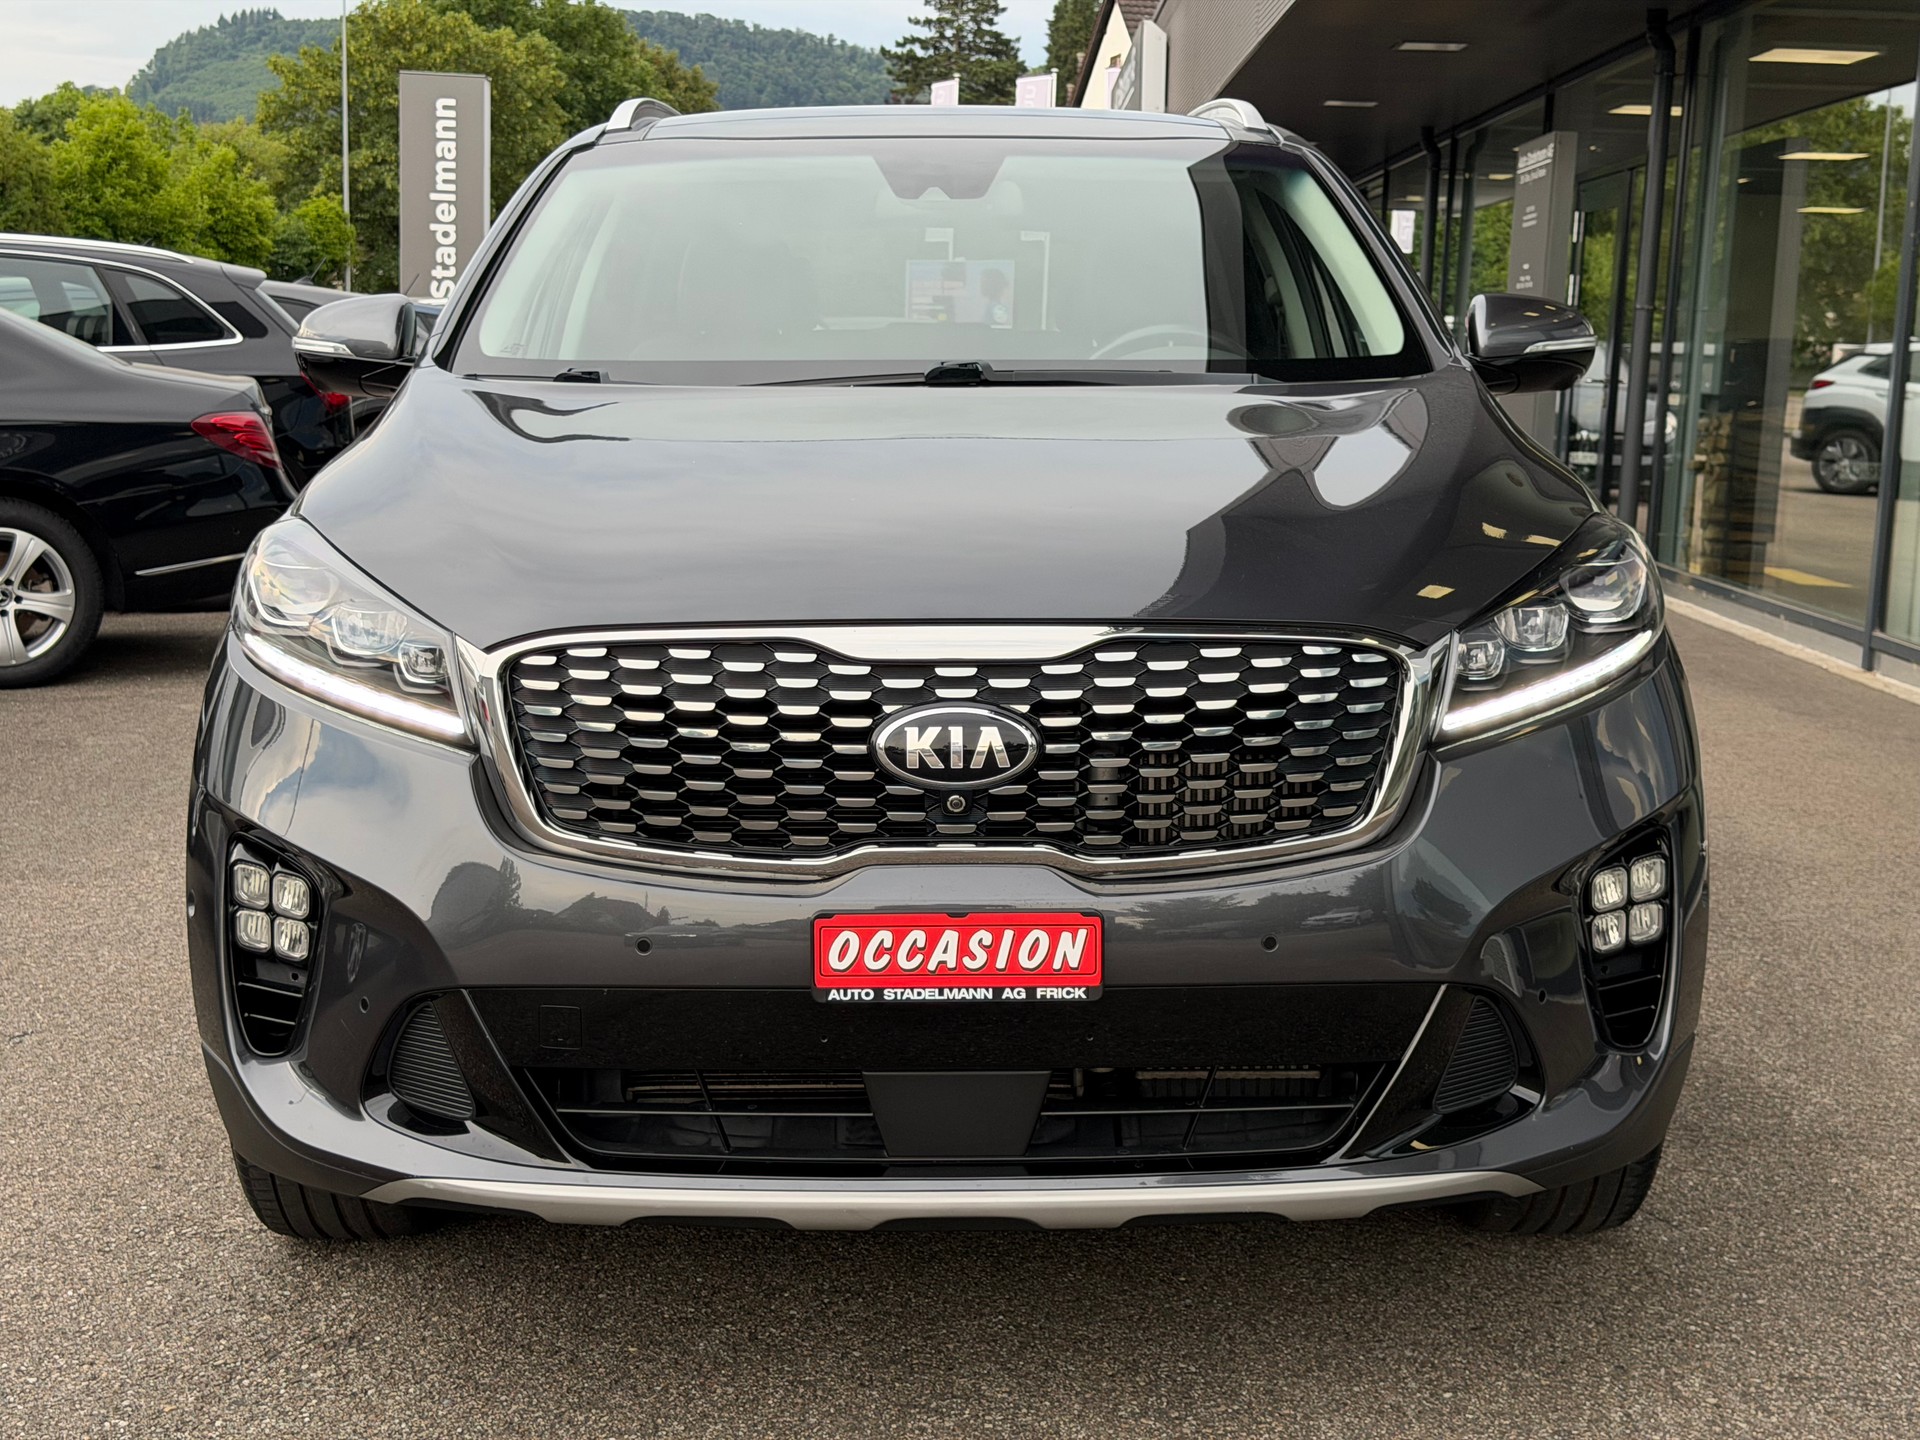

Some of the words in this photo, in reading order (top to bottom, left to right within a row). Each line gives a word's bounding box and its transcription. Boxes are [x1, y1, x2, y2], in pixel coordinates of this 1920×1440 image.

[429, 97, 457, 298] Stadelmann
[904, 726, 1011, 769] KIA
[827, 928, 1089, 974] OCCASION
[827, 988, 875, 1001] AUTO
[883, 987, 993, 1000] STADELMANN
[1001, 987, 1027, 999] AG
[1036, 987, 1087, 999] FRICK
